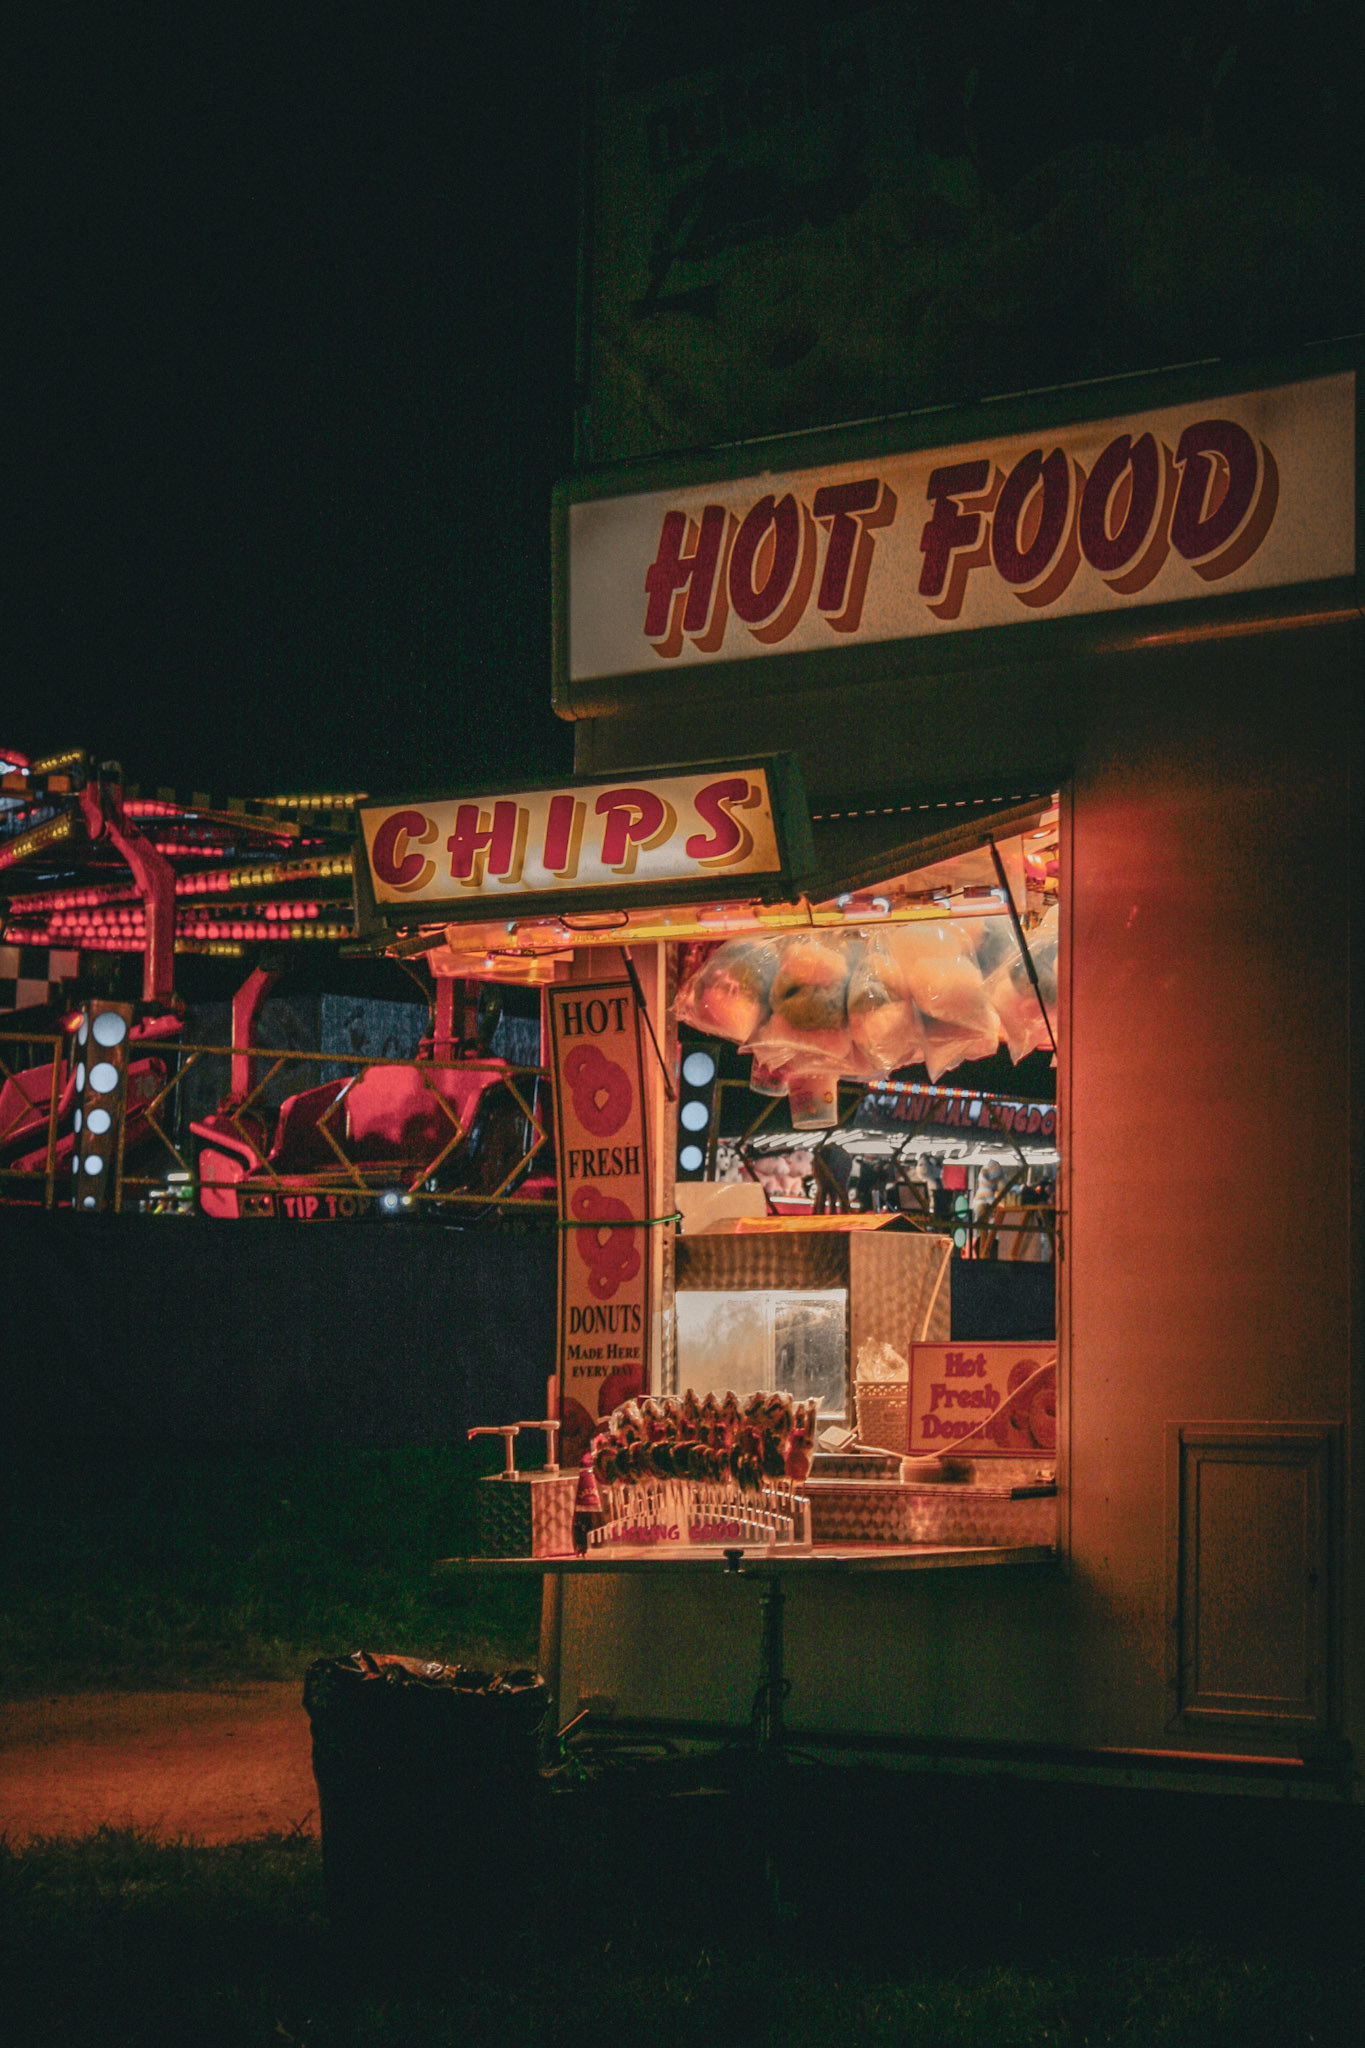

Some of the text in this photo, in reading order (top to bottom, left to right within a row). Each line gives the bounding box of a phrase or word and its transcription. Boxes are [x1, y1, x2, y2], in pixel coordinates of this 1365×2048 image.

[644, 419, 1279, 658] HOT FOOD
[372, 778, 762, 892] CHIPS
[561, 998, 629, 1036] HOT
[569, 1146, 640, 1178] FRESH
[283, 1195, 319, 1218] TIP
[570, 1304, 641, 1334] DONUTS
[573, 1365, 633, 1378] EVERY DAY
[945, 1353, 987, 1378] Hot
[930, 1383, 1000, 1413] Fresh
[688, 1522, 740, 1541] GOOD
